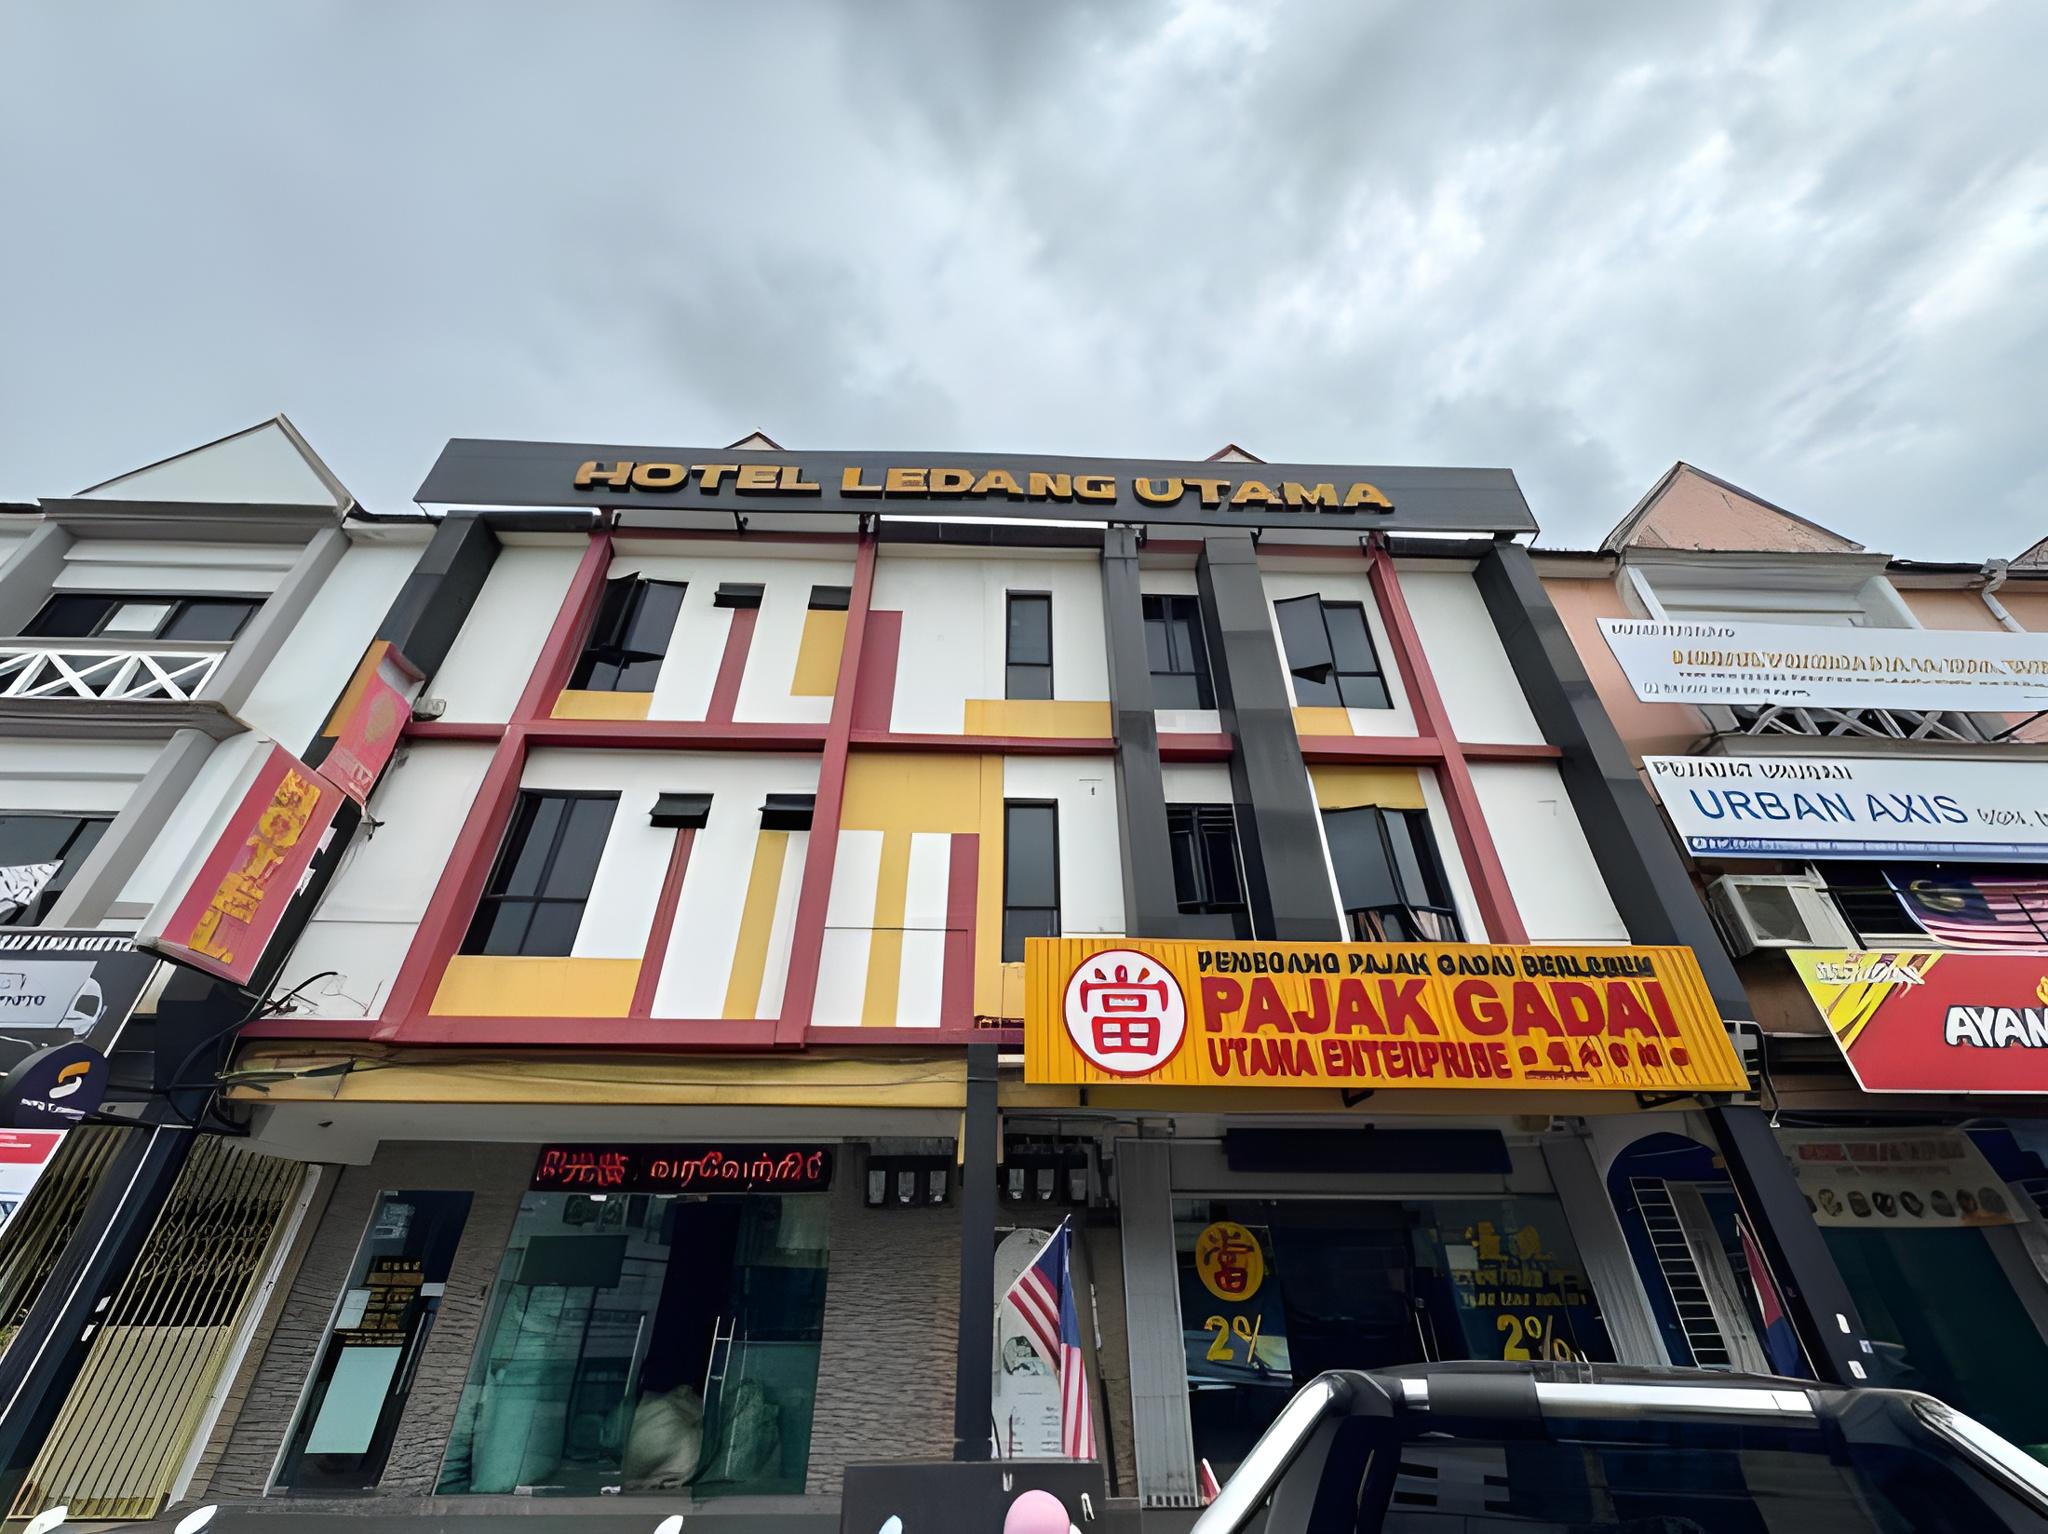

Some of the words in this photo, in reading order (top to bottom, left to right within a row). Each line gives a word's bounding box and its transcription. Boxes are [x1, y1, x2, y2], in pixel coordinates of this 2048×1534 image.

[573, 460, 821, 497] HOTEL
[840, 466, 1117, 504] LEDANG
[1132, 476, 1395, 514] UTAMA
[1689, 788, 1856, 822] URBAN
[1866, 793, 1969, 824] AXIS
[1079, 964, 1169, 1056] 當
[1201, 976, 1440, 1036] PAJAK
[1453, 979, 1682, 1038] GADAI
[1496, 1314, 1571, 1361] 2%
